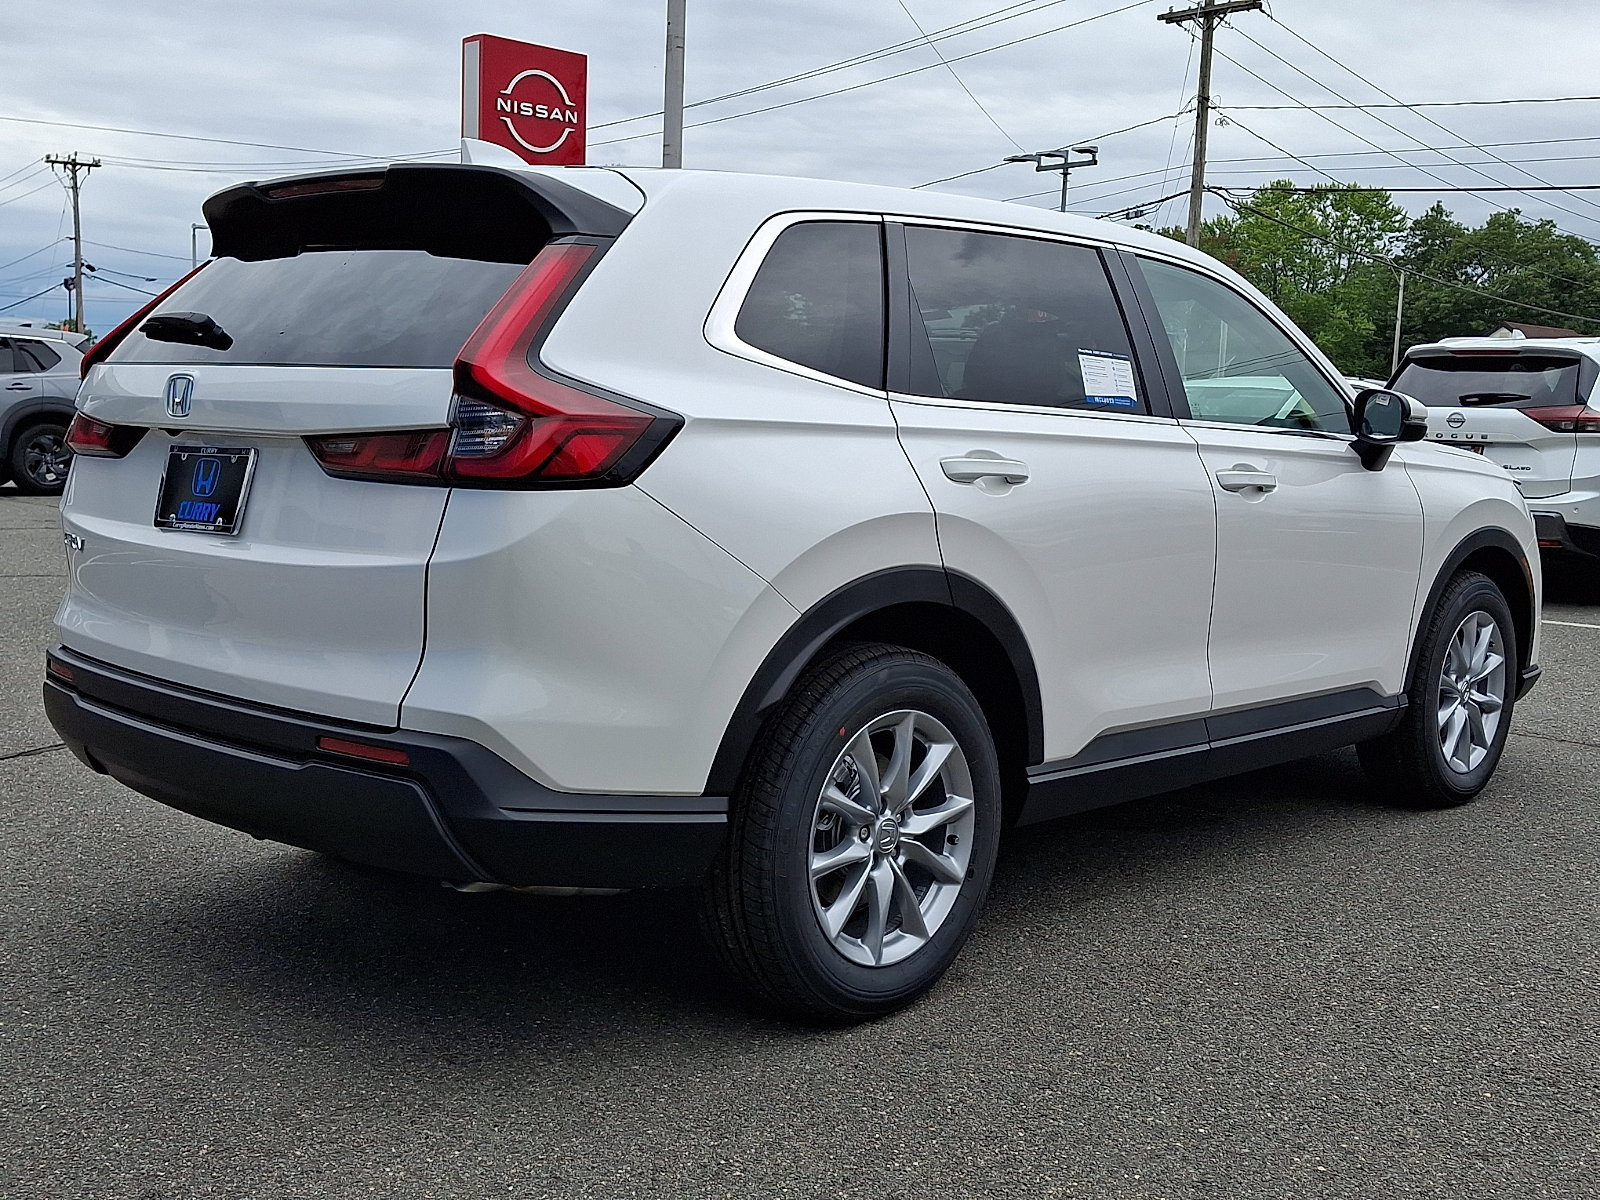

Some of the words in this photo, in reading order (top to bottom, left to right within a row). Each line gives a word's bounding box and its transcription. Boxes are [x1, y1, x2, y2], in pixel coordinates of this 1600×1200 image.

[497, 98, 577, 124] NISSAN
[201, 447, 218, 455] CURRY
[177, 500, 221, 522] CURRY
